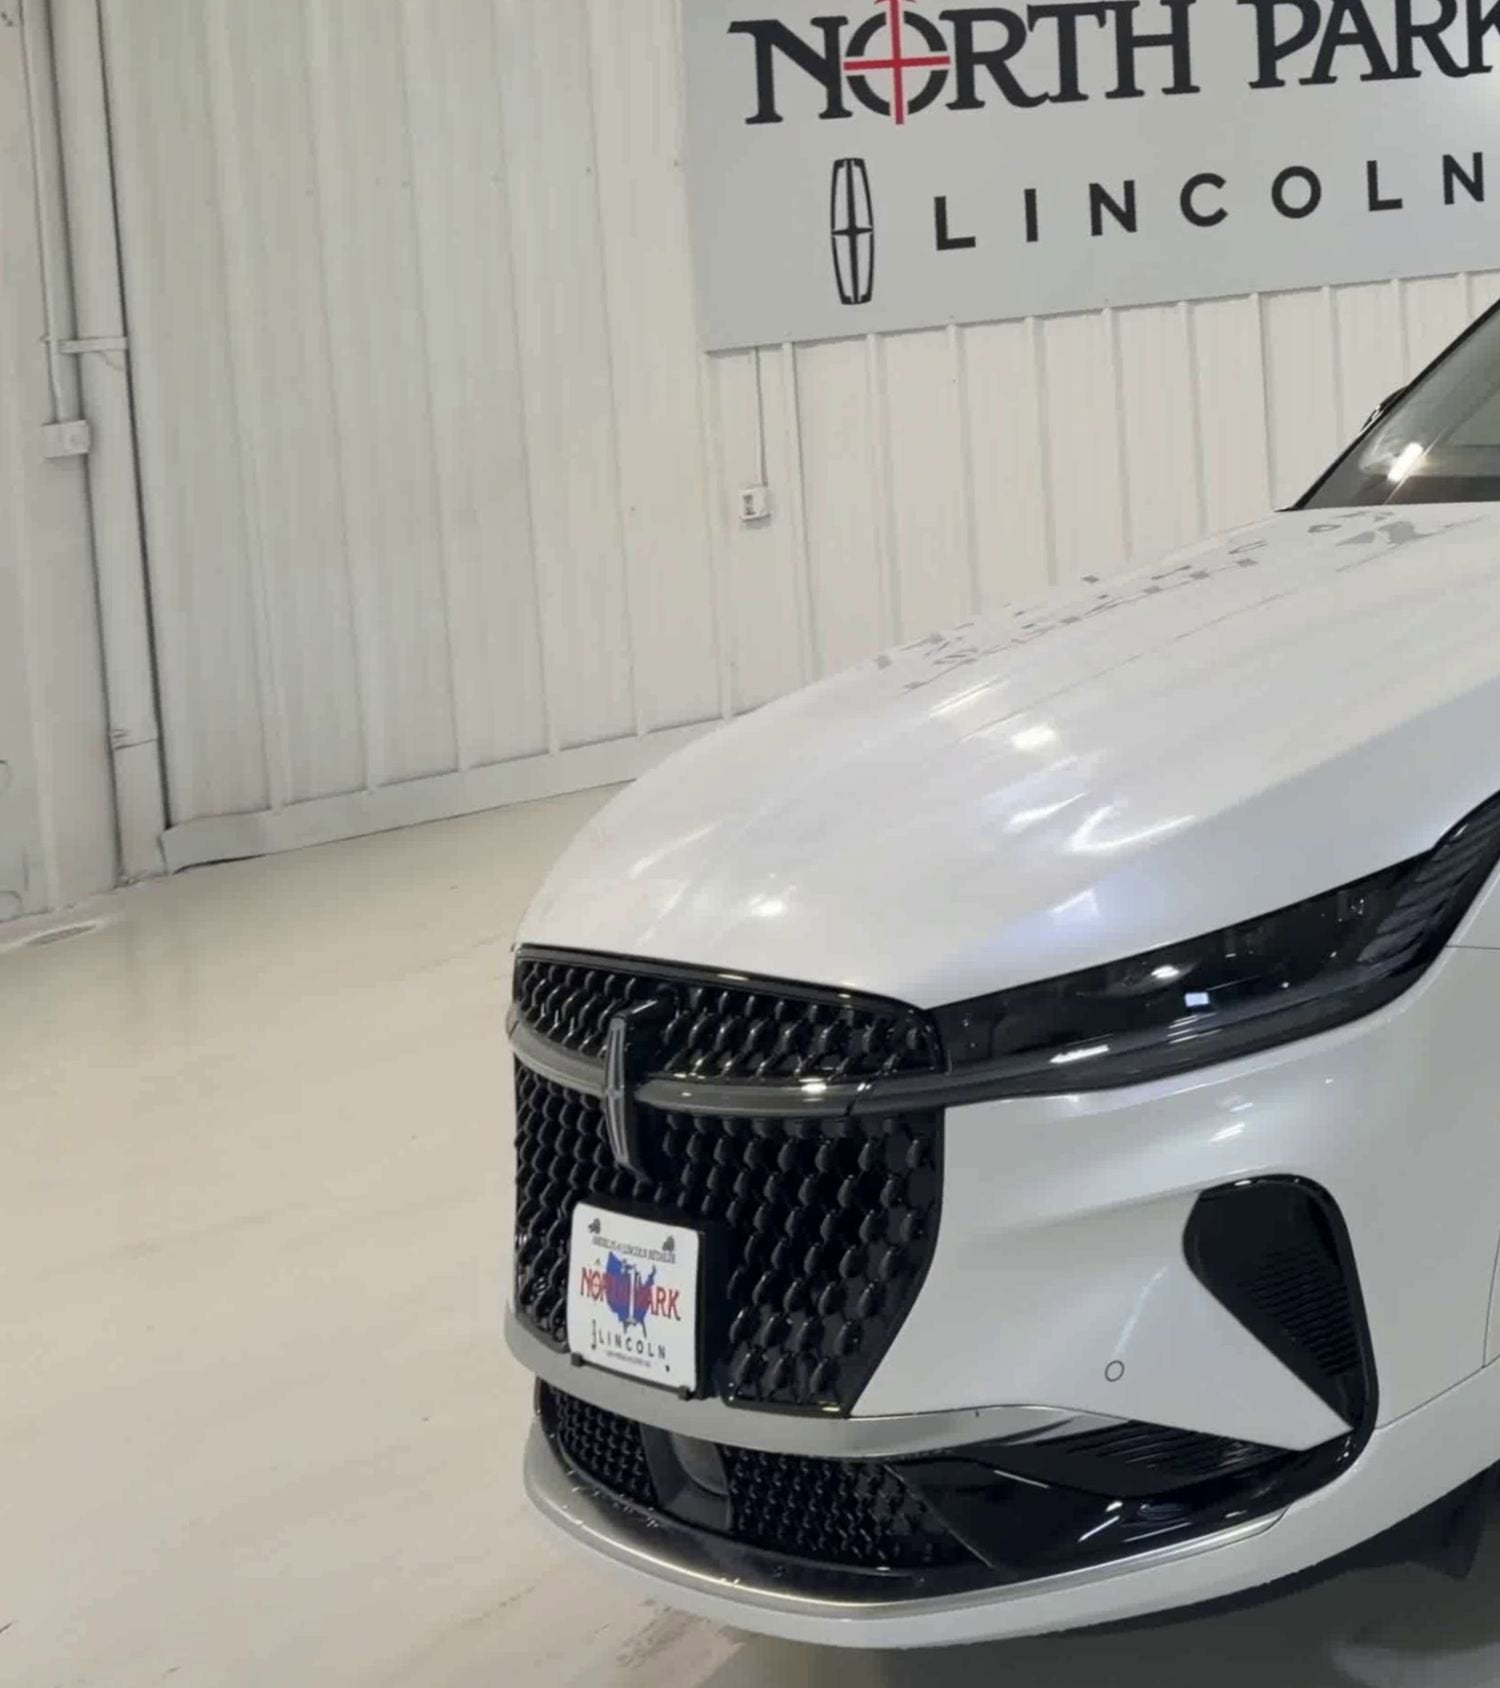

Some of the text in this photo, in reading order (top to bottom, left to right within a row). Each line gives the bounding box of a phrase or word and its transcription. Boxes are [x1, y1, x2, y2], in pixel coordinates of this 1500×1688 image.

[727, 0, 1201, 125] NORTH
[934, 151, 1485, 251] LINCOLN
[598, 1329, 666, 1360] LINCOLN
